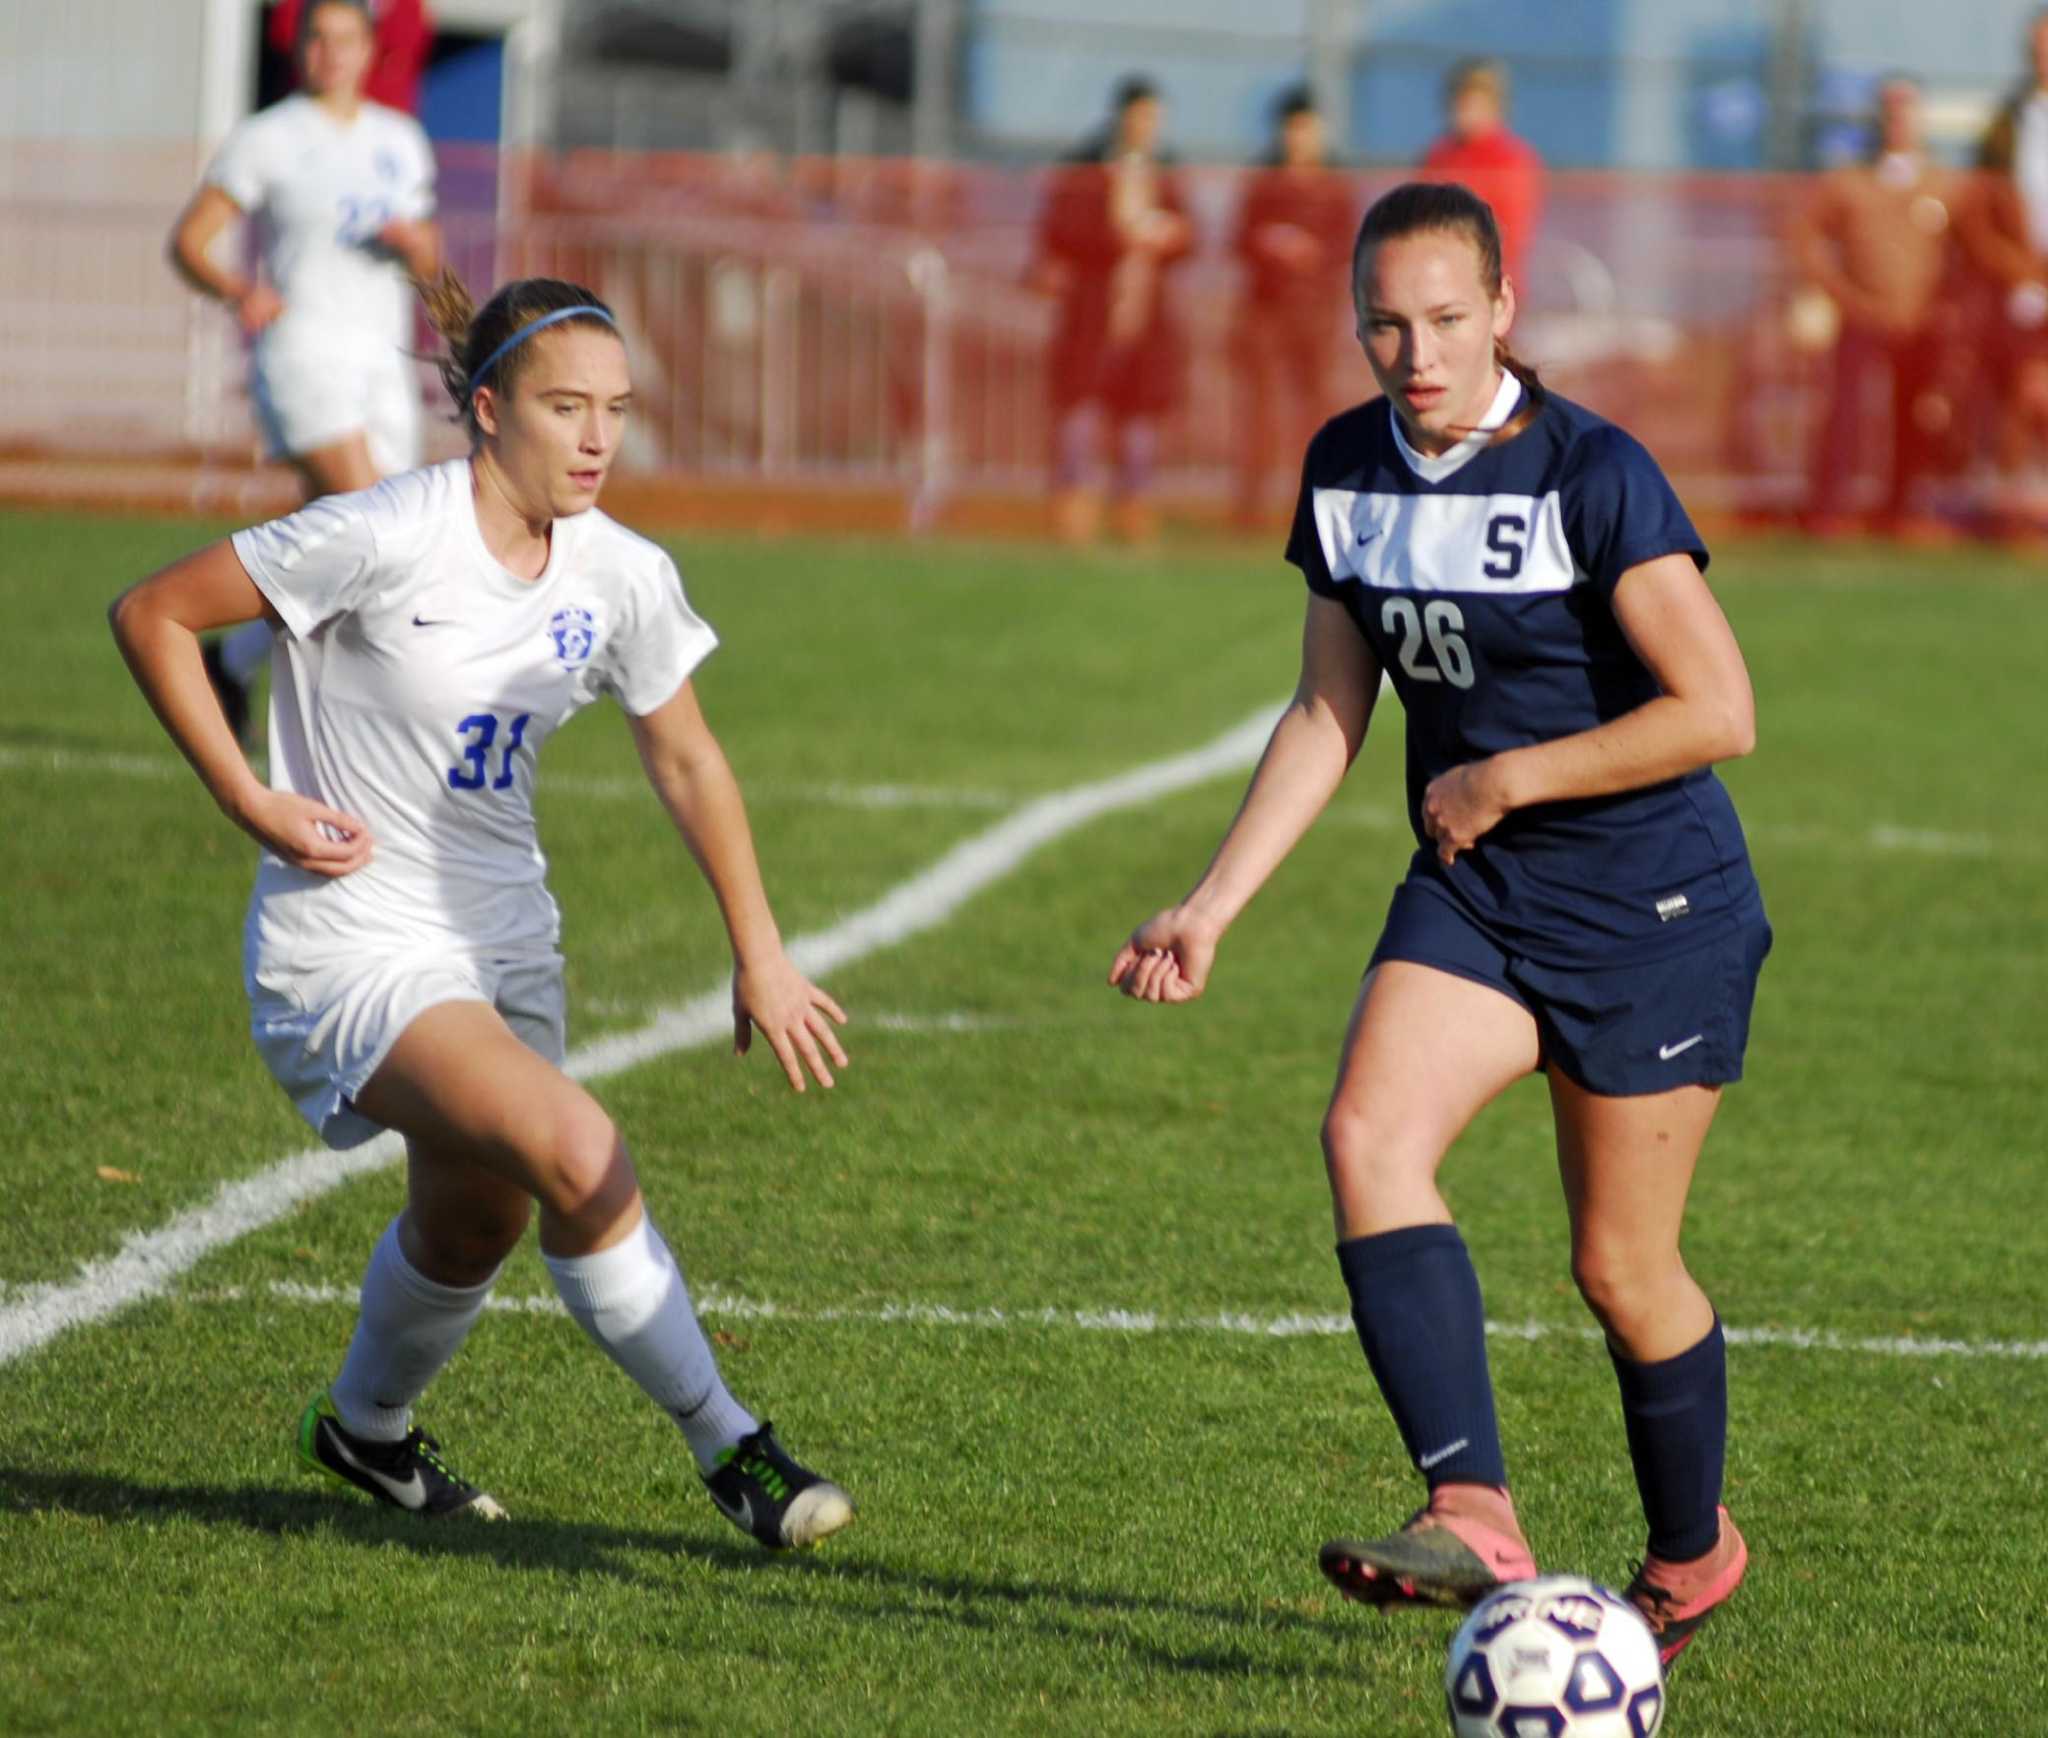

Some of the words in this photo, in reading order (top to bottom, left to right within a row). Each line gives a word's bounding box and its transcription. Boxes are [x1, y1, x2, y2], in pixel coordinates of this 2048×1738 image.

[1483, 514, 1526, 579] S
[1381, 596, 1475, 689] 26
[448, 713, 530, 790] 31
